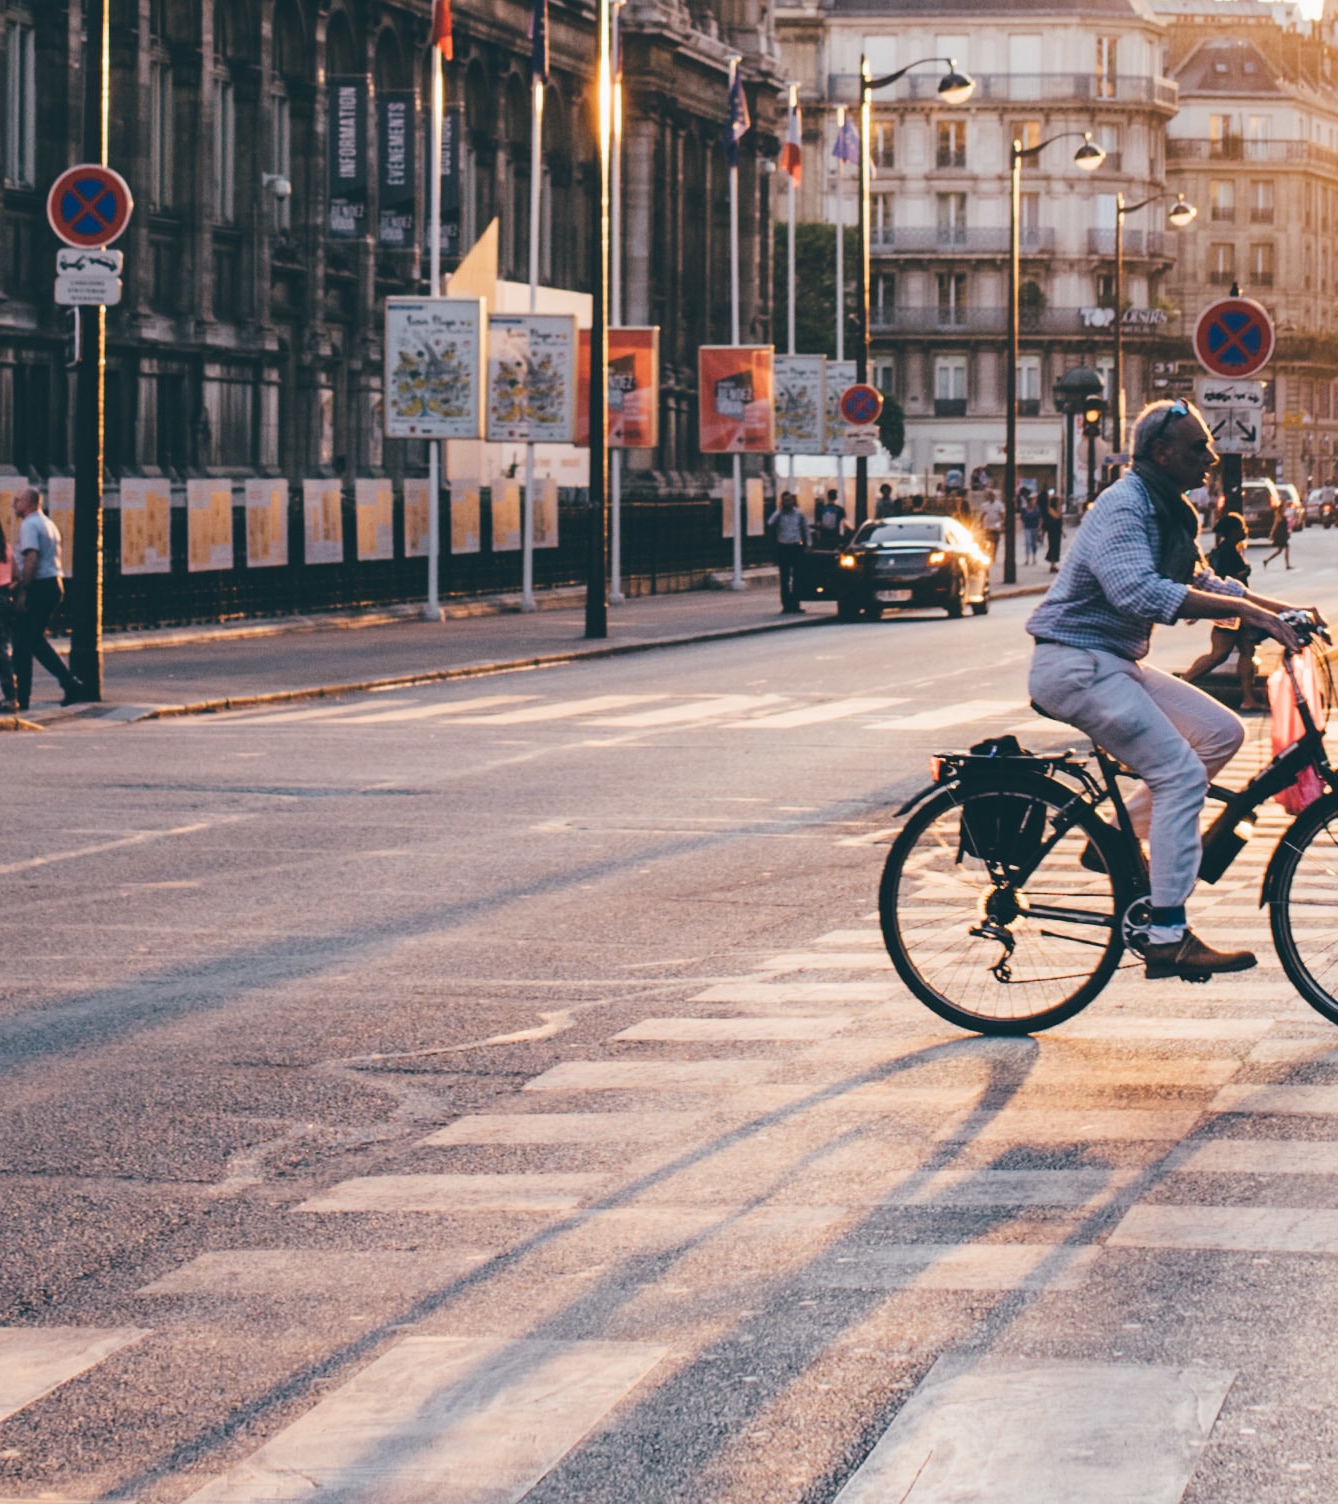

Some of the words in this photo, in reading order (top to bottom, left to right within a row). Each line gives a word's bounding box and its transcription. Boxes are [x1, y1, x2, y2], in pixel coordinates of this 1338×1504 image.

[338, 86, 357, 178] INFORMATION
[387, 102, 406, 185] ÉVÉNEMENTS
[1080, 307, 1116, 328] TOP
